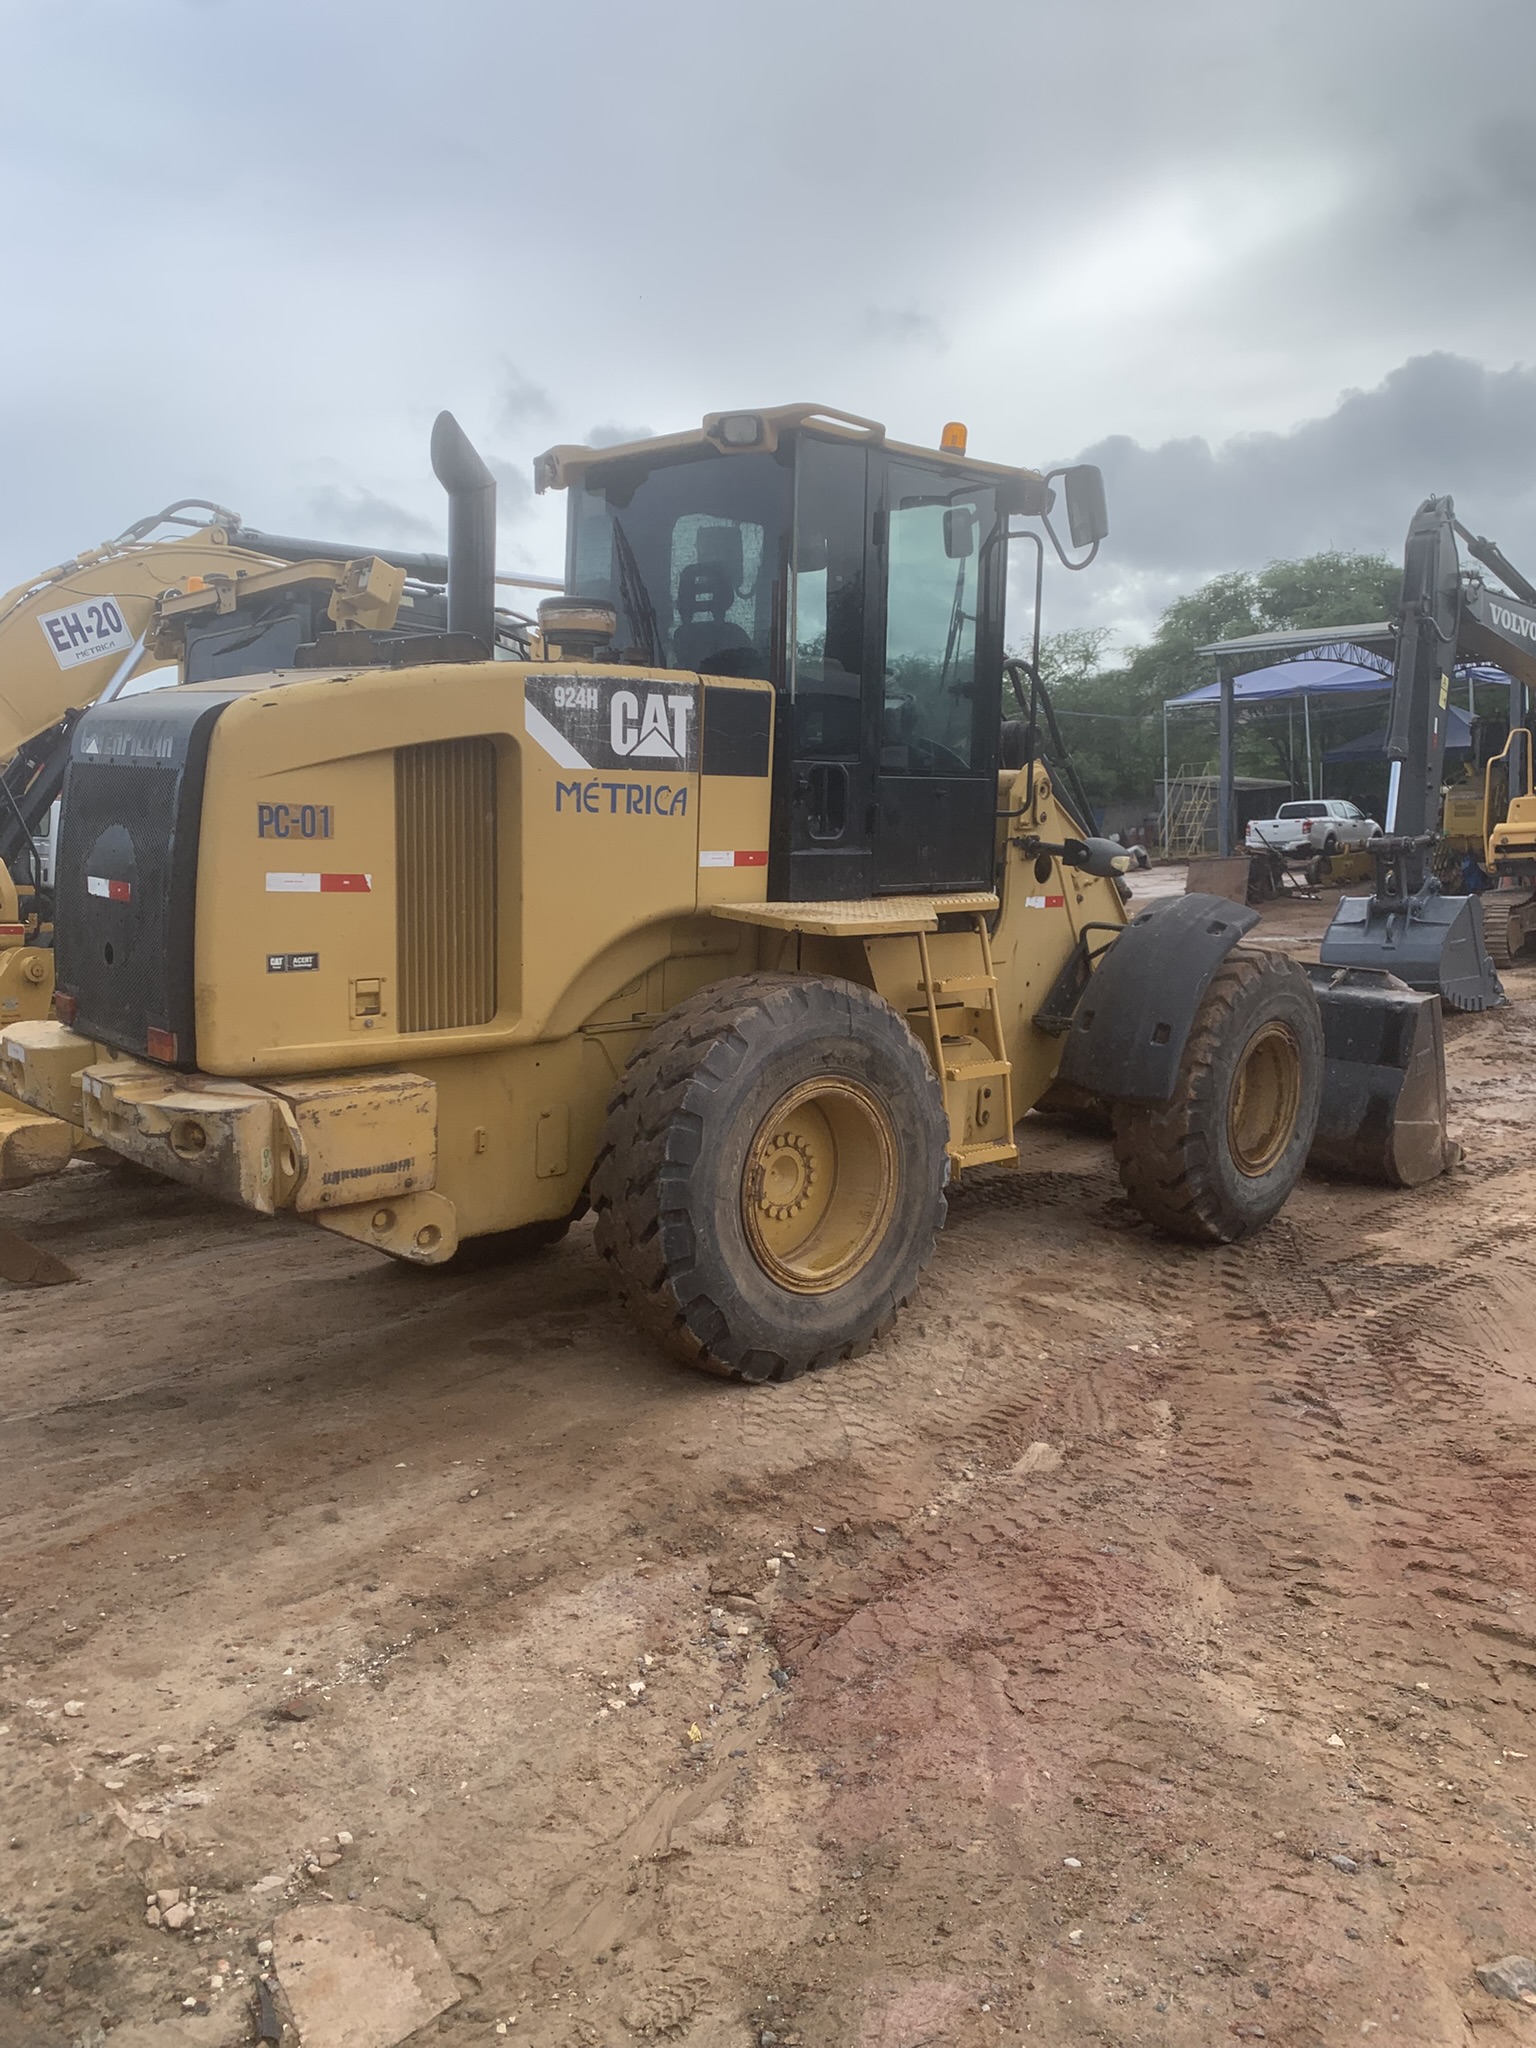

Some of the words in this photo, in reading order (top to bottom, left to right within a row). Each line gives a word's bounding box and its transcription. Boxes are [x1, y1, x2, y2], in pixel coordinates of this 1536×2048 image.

[45, 601, 122, 652] EH-20
[1489, 602, 1536, 641] VOLVO
[554, 686, 598, 709] 924H
[610, 690, 694, 758] CAT
[555, 777, 687, 816] MÉTRICA
[258, 804, 329, 838] PC-01
[270, 957, 283, 966] CAT
